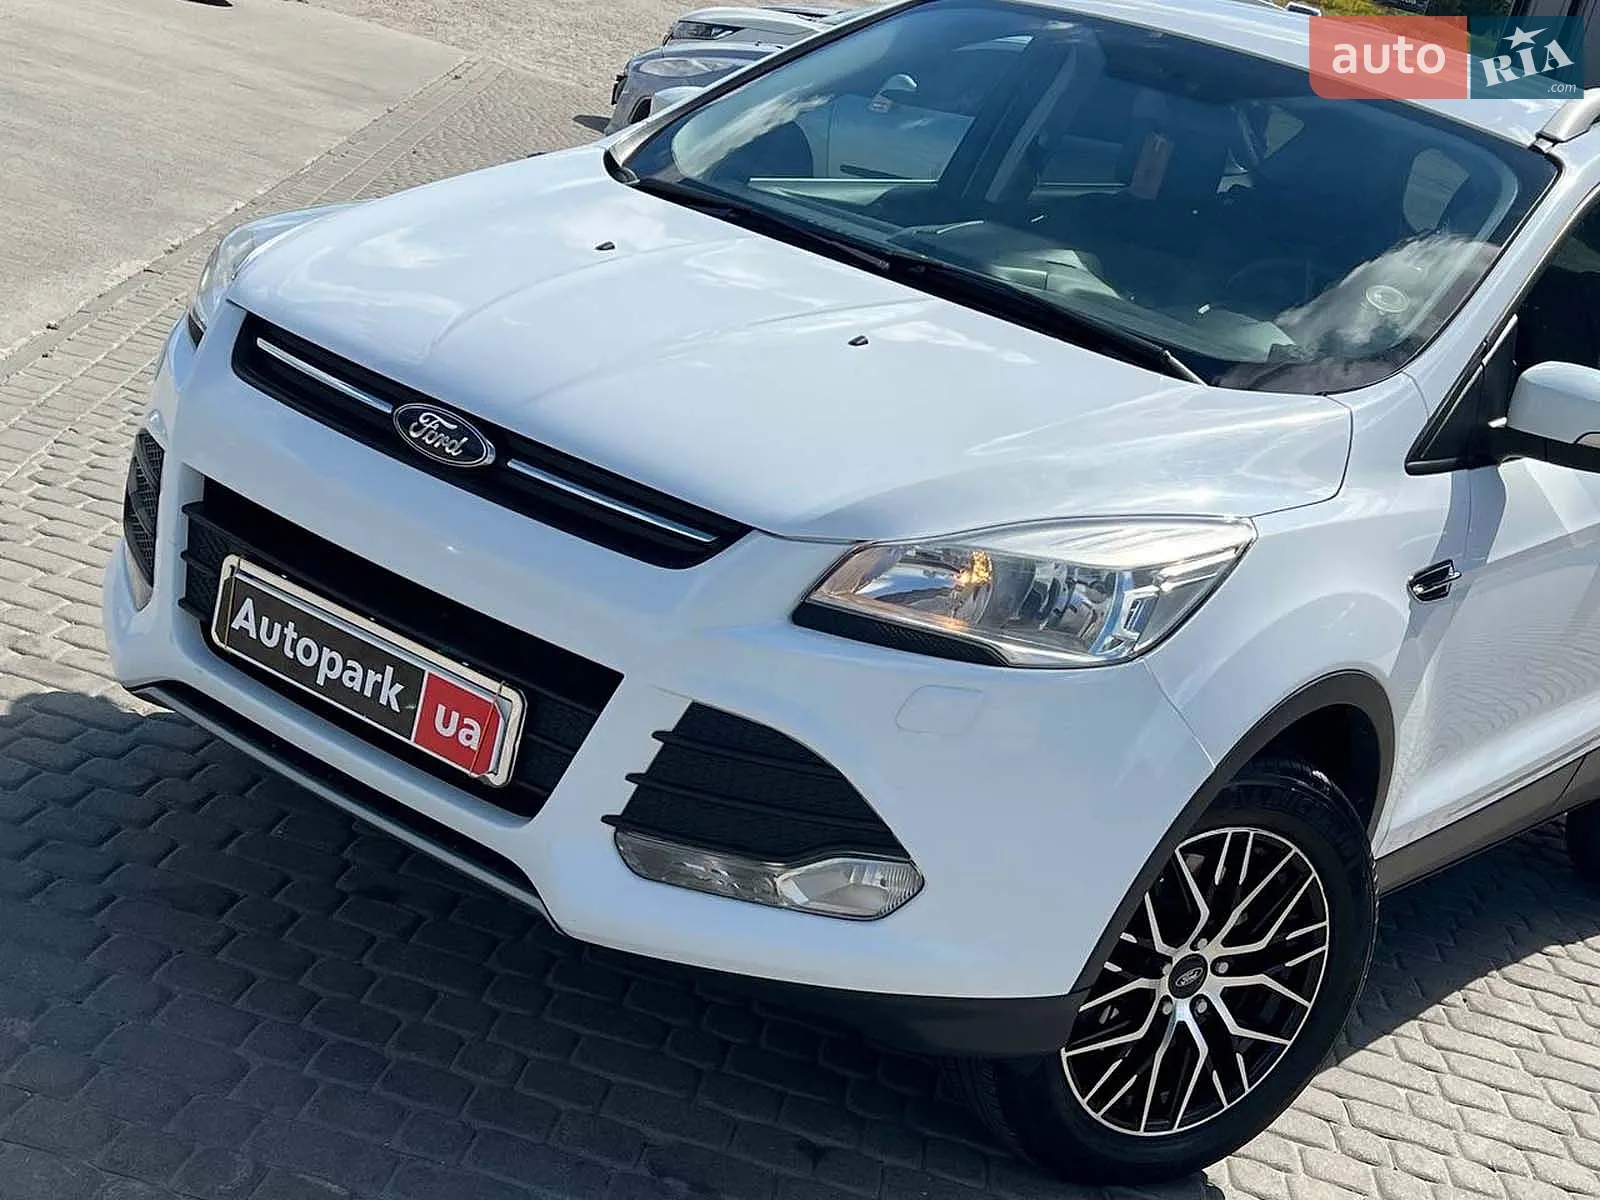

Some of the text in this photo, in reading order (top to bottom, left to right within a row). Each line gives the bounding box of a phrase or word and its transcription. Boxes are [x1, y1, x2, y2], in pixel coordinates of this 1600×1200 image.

[408, 412, 468, 456] Ford
[231, 597, 481, 749] Autopark ua
